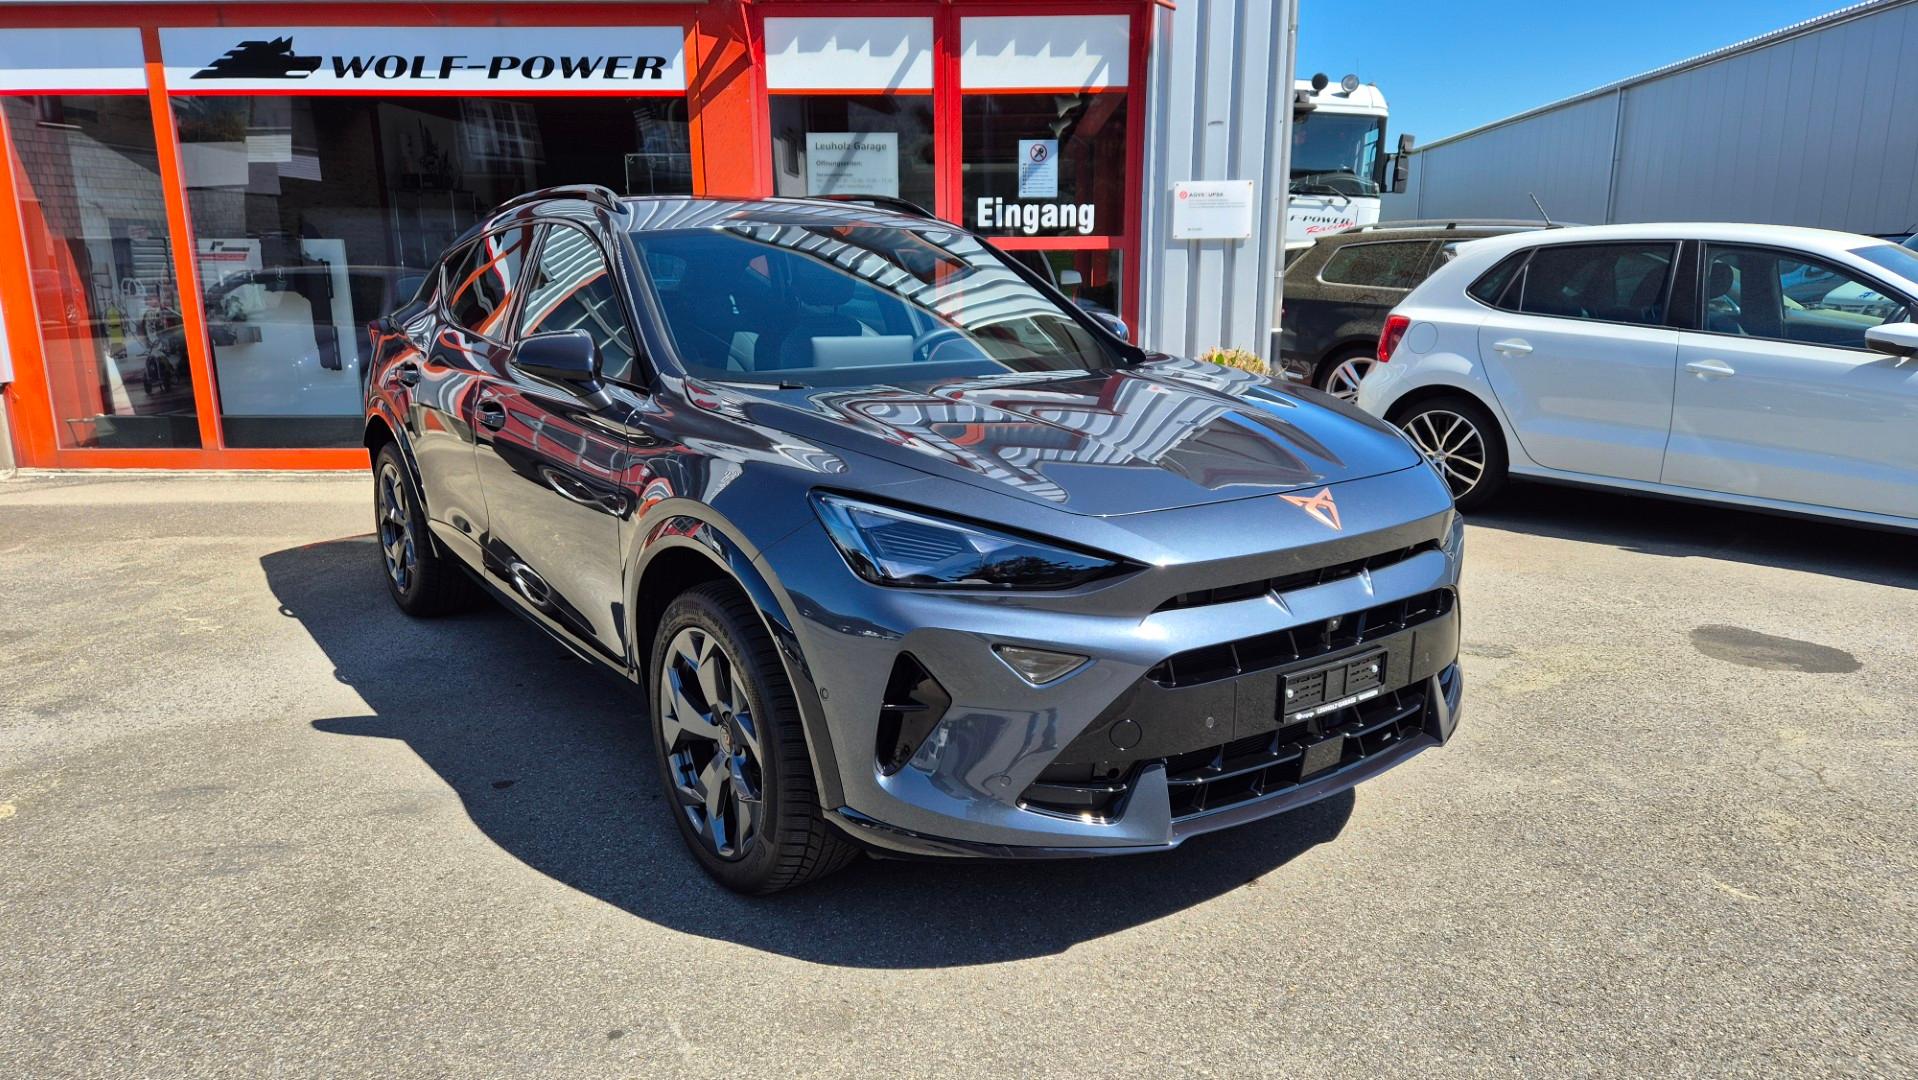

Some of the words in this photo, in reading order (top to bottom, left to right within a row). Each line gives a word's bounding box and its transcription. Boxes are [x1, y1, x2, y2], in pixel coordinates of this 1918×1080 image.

[332, 55, 666, 79] WOLF-POWER
[815, 142, 851, 151] Leuholz
[854, 142, 887, 152] Garage
[977, 197, 1095, 234] Eingang
